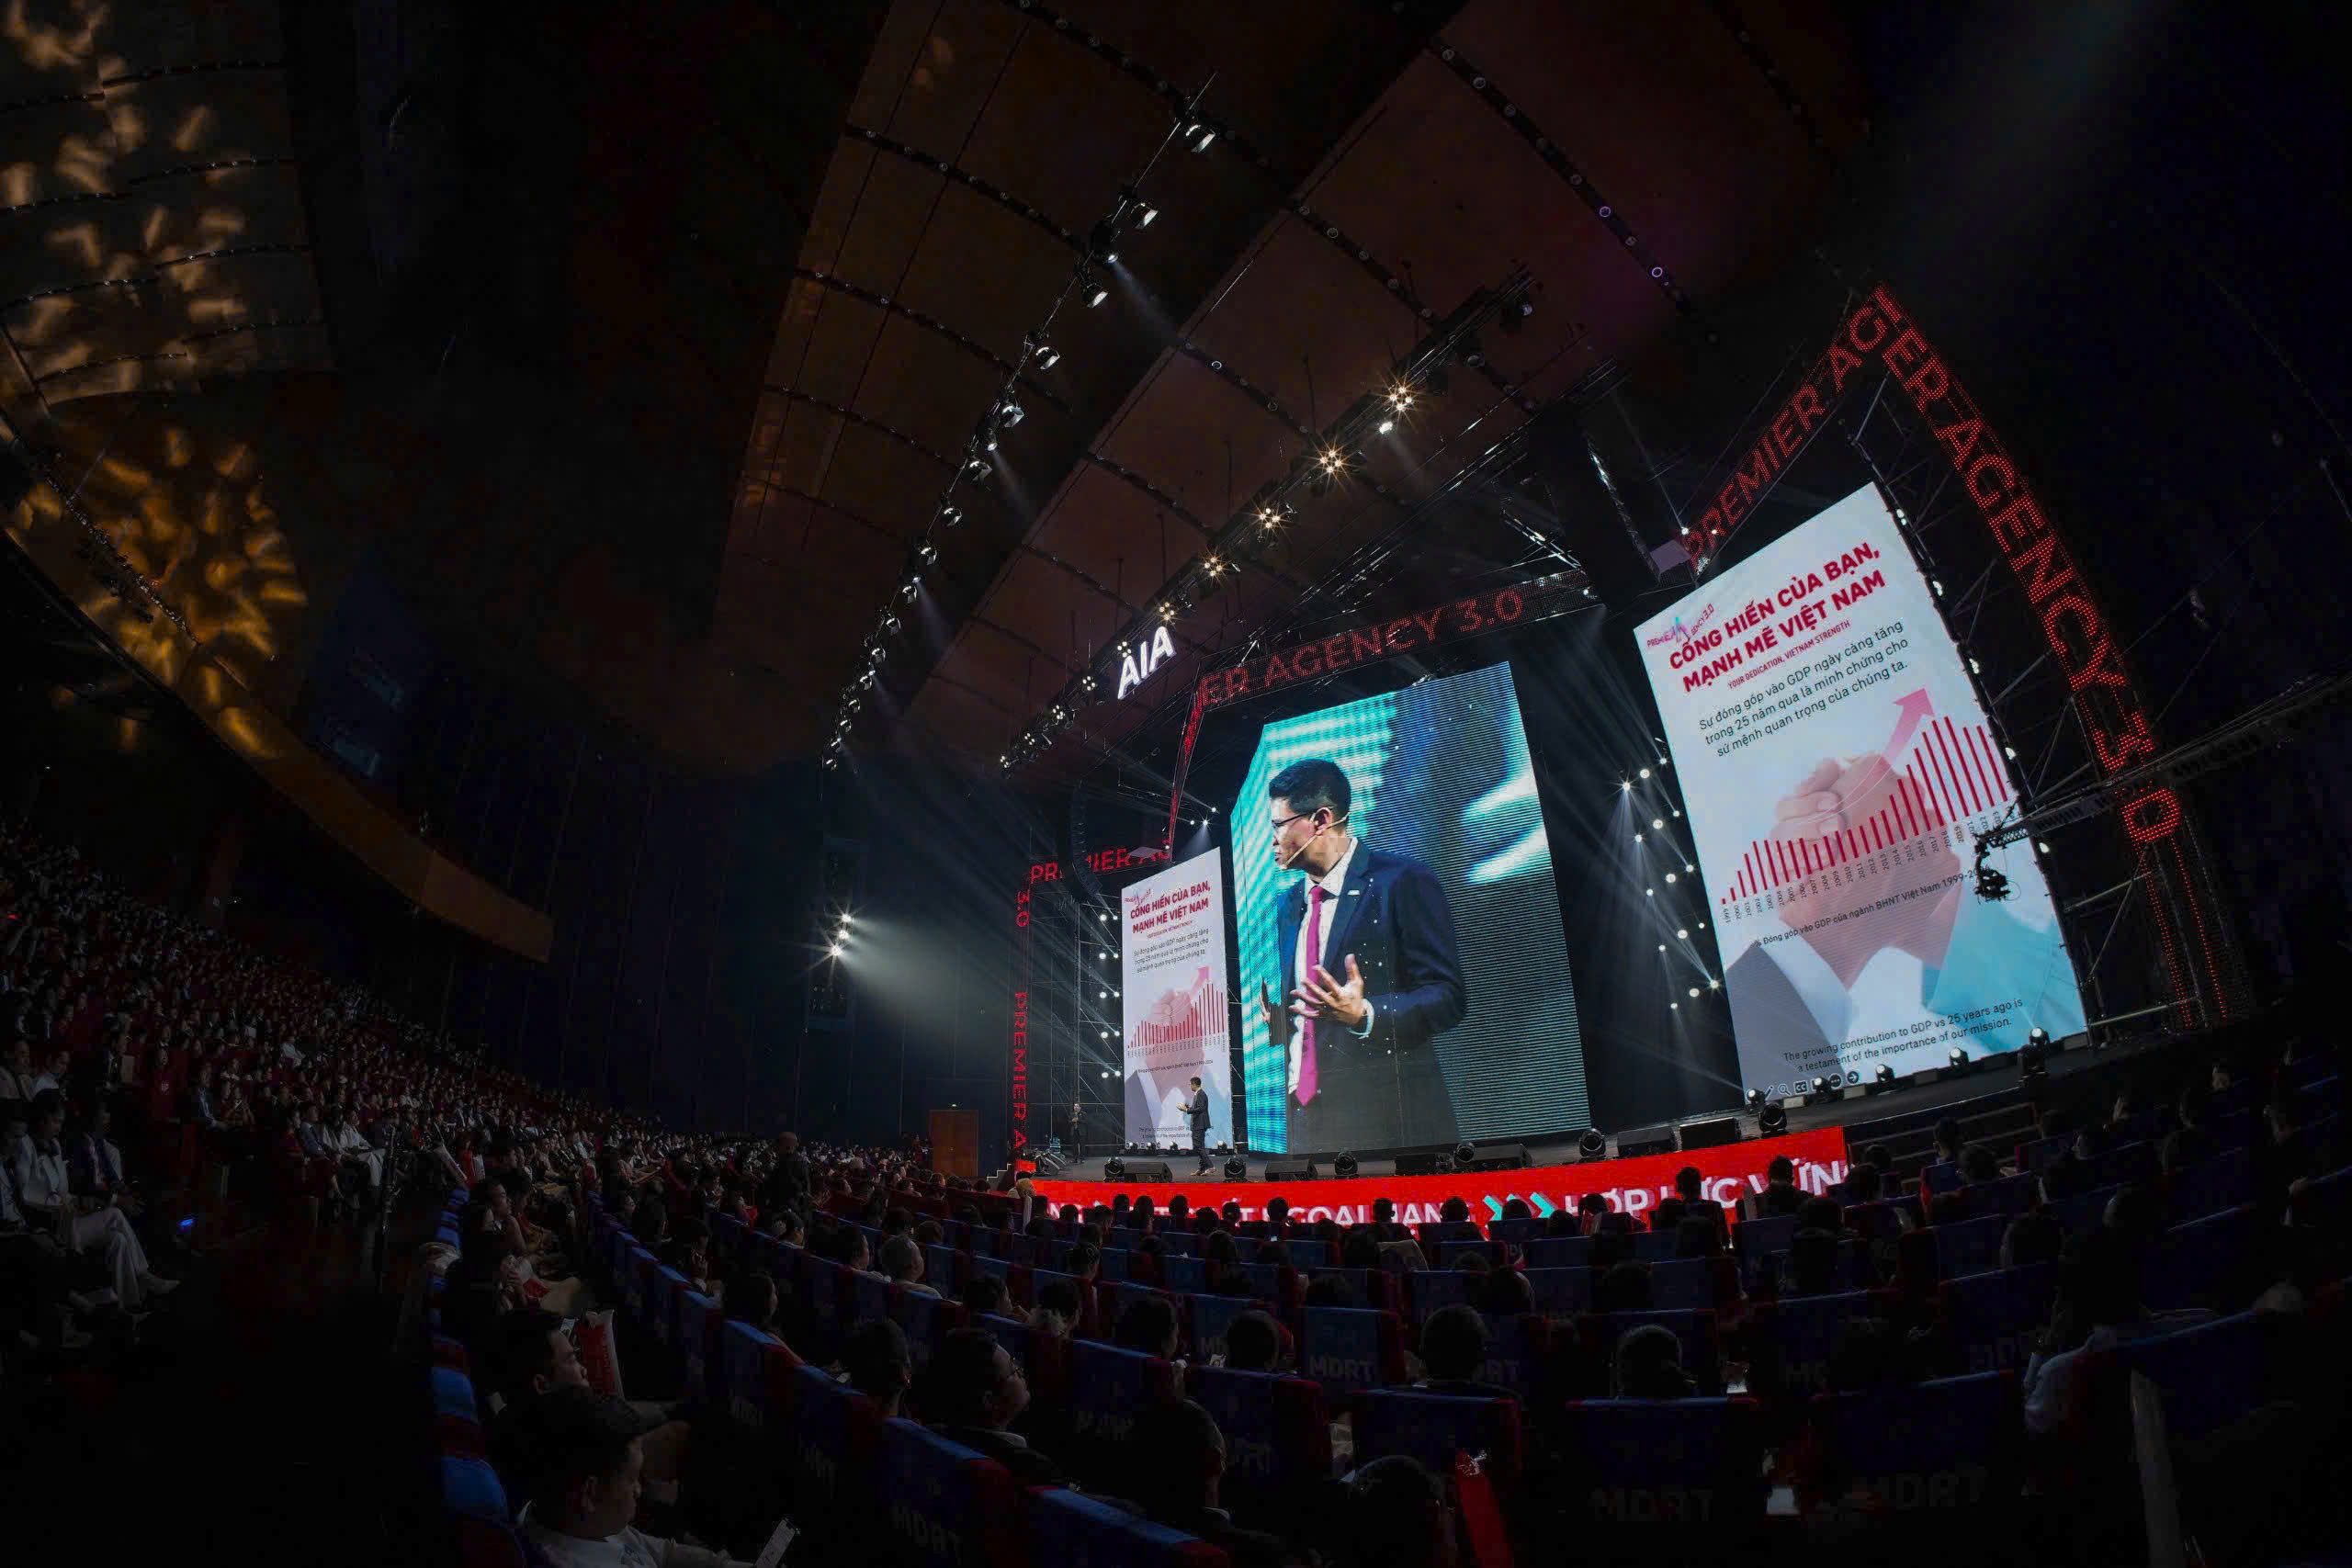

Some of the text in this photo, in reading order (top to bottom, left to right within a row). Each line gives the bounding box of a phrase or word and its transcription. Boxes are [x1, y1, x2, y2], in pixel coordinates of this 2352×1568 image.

[1777, 573, 1824, 607] CỦA
[1117, 626, 1176, 700] AIA
[1265, 607, 1442, 687] AGENCY
[1456, 591, 1523, 632] 3.0
[1682, 648, 1743, 693] MẠNH
[1779, 600, 1828, 640] VIỆT
[1831, 570, 1886, 612] NAM
[1744, 692, 1764, 709] góp
[1766, 682, 1785, 698] vào
[1787, 666, 1811, 686] GDP
[1815, 652, 1841, 673] ngày
[1844, 637, 1873, 657] càng
[1875, 621, 1905, 642] tăng
[1815, 619, 1851, 644] STRENGTH
[1935, 421, 2128, 691] AGENCY
[2094, 711, 2181, 842] 30
[1705, 726, 1734, 745] trong
[1736, 716, 1750, 731] 25
[1778, 693, 1800, 711] qua
[1800, 685, 1814, 698] là
[1815, 670, 1845, 692] minh
[1885, 637, 1909, 656] cho
[1765, 715, 1793, 734] quan
[1794, 700, 1826, 721] trọng
[1827, 687, 1850, 705] của
[1891, 660, 1909, 674] ta.
[1031, 848, 1131, 884] PRIER
[1189, 897, 1209, 914] NAM
[1815, 918, 1831, 929] GDP
[1920, 882, 1940, 895] Nam
[1012, 991, 1028, 1121] PREMIER
[1783, 998, 2023, 1062] The growing contribution to GDP vs 25 years ago is
[1805, 1055, 1851, 1071] testament
[1852, 1051, 1862, 1062] of
[1863, 1046, 1880, 1058] the
[1881, 1035, 1938, 1056] importance
[1939, 1032, 1949, 1043] of
[1951, 1028, 1968, 1039] our
[1969, 1018, 2012, 1036] mission.
[1308, 1355, 1375, 1380] MDRT
